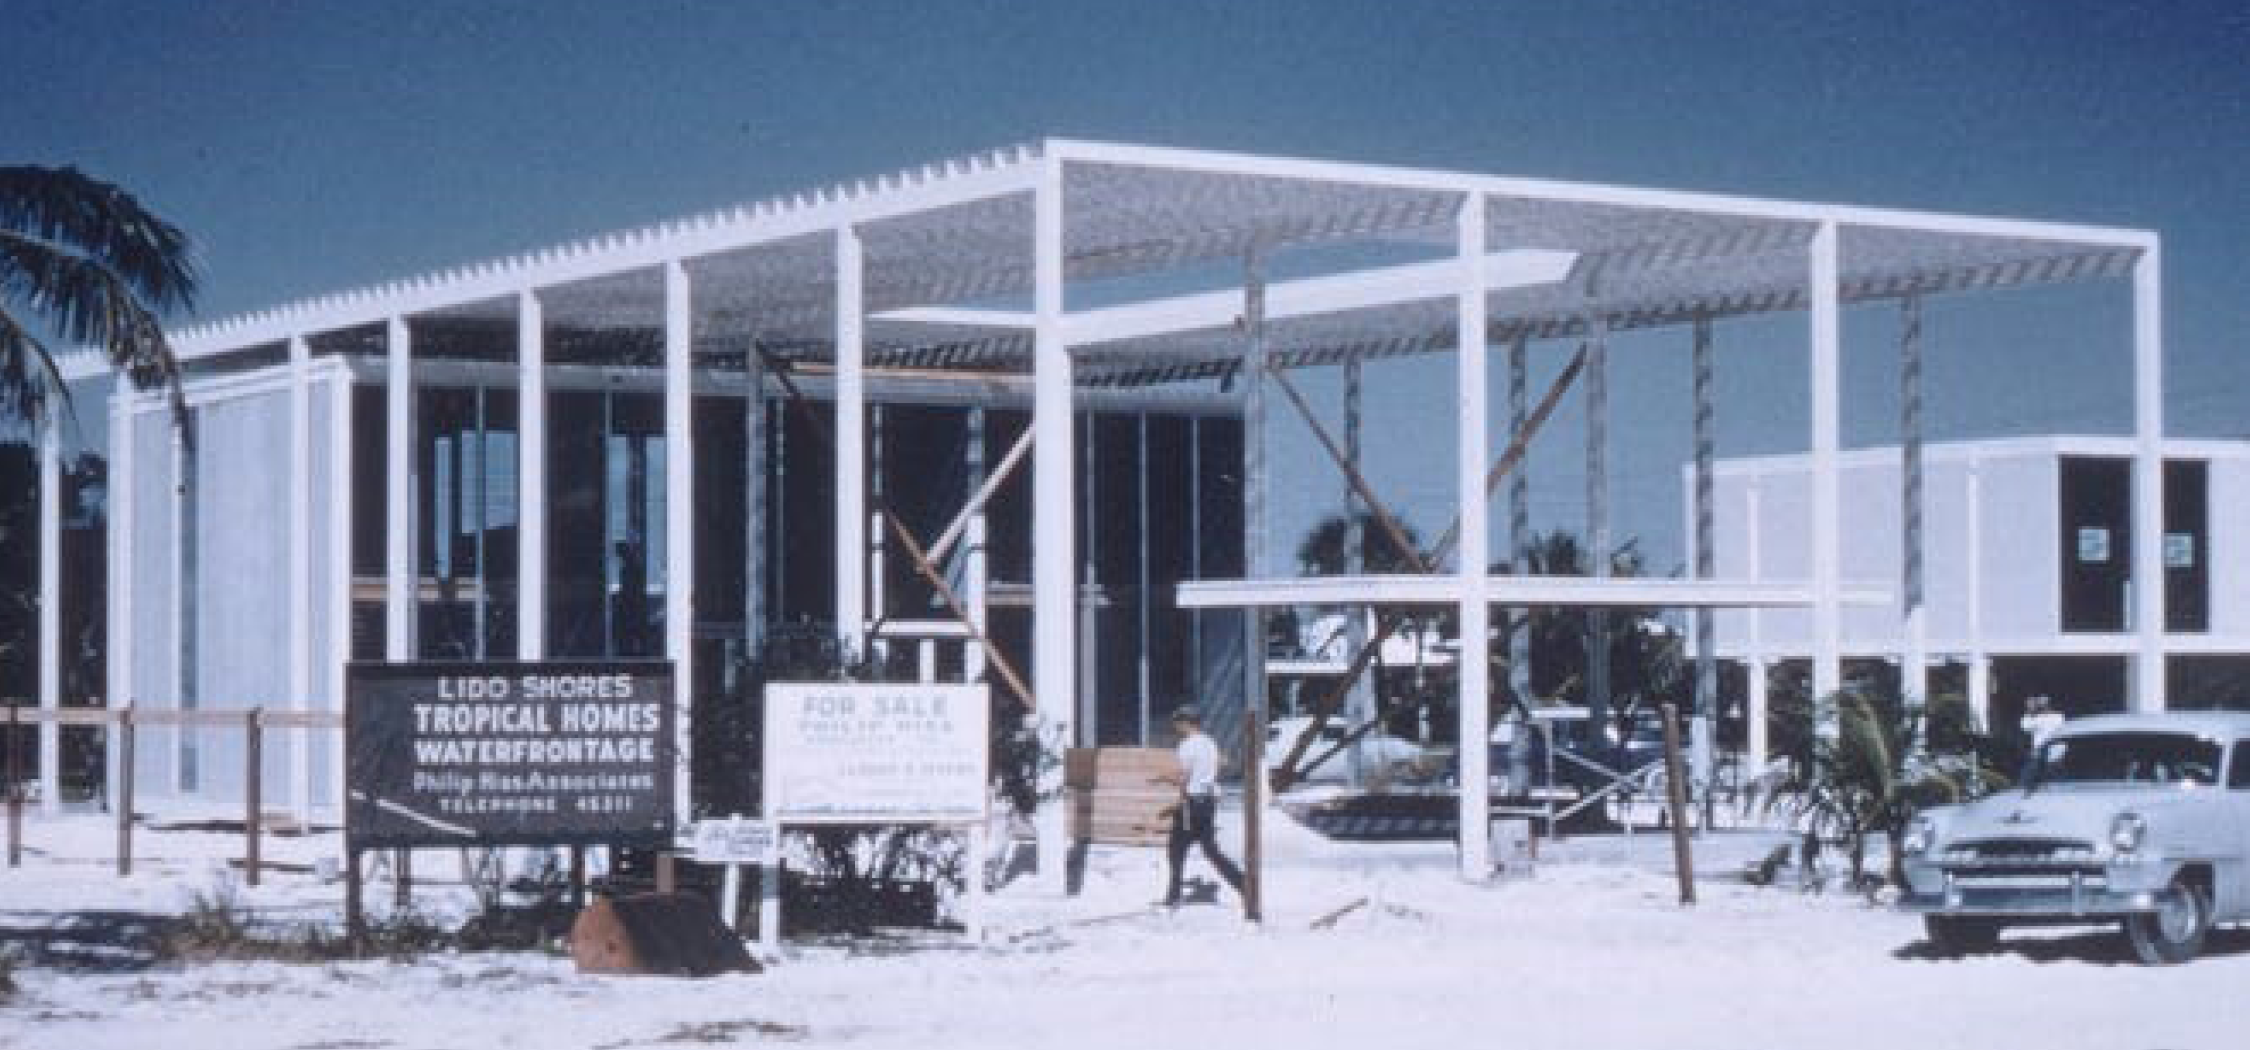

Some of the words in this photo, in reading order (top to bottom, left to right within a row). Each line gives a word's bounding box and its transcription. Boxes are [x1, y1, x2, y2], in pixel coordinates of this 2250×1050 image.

[439, 676, 510, 700] LIDO
[522, 674, 632, 699] SHORES
[414, 703, 551, 732] TROPICAL
[562, 703, 660, 732] HOMES
[804, 696, 856, 718] FOR
[873, 695, 949, 718] SALE
[414, 738, 653, 763] WATERFRONTAGE
[413, 769, 474, 797] Philip
[527, 770, 653, 791] Associates
[440, 797, 556, 813] TELEPHONE
